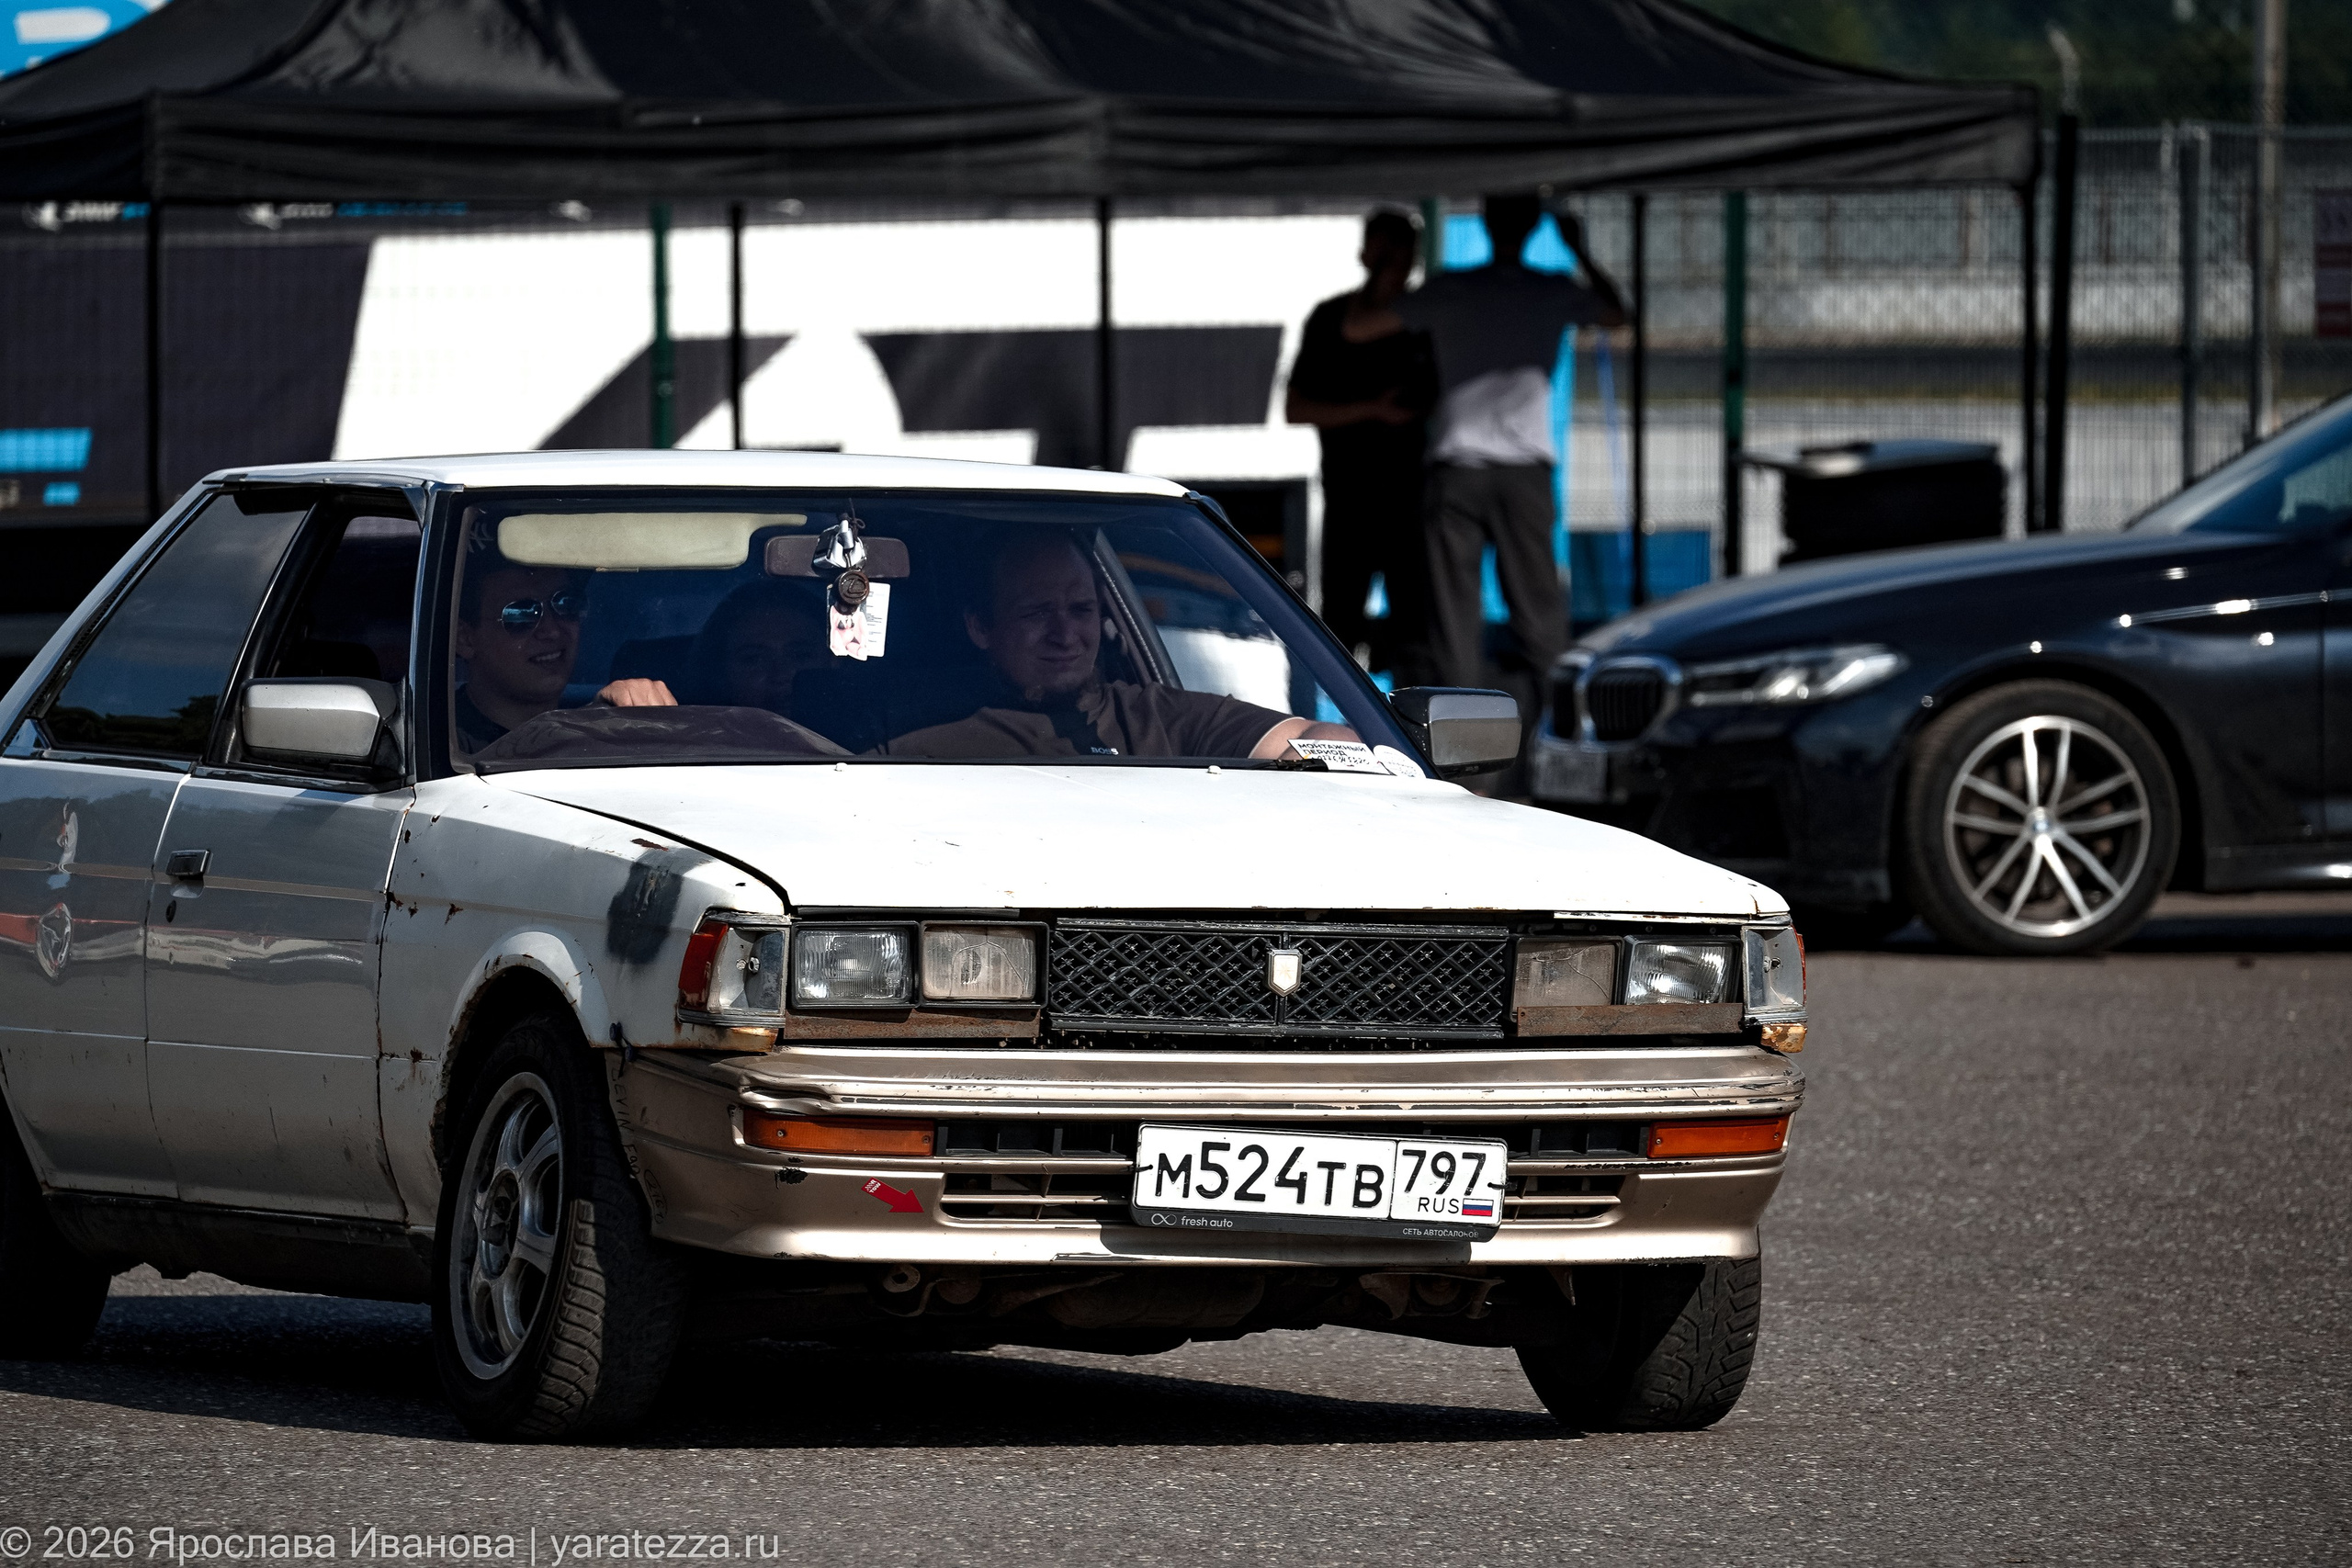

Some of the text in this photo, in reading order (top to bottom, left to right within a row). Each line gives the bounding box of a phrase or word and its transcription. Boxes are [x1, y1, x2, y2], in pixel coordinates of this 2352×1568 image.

[1091, 747, 1119, 755] BOSS
[1297, 743, 1366, 752] МОНТАЖНЫЙ
[1303, 749, 1347, 757] ПЕРИОД
[611, 1067, 635, 1133] LEVIN
[1155, 1142, 1487, 1208] М524ТВ 797
[868, 1181, 881, 1193] TOW
[1418, 1197, 1459, 1213] RUS
[1181, 1215, 1233, 1228] fresh auto
[1402, 1227, 1479, 1238] СЕТЬ АВТОСАЛОНОВ
